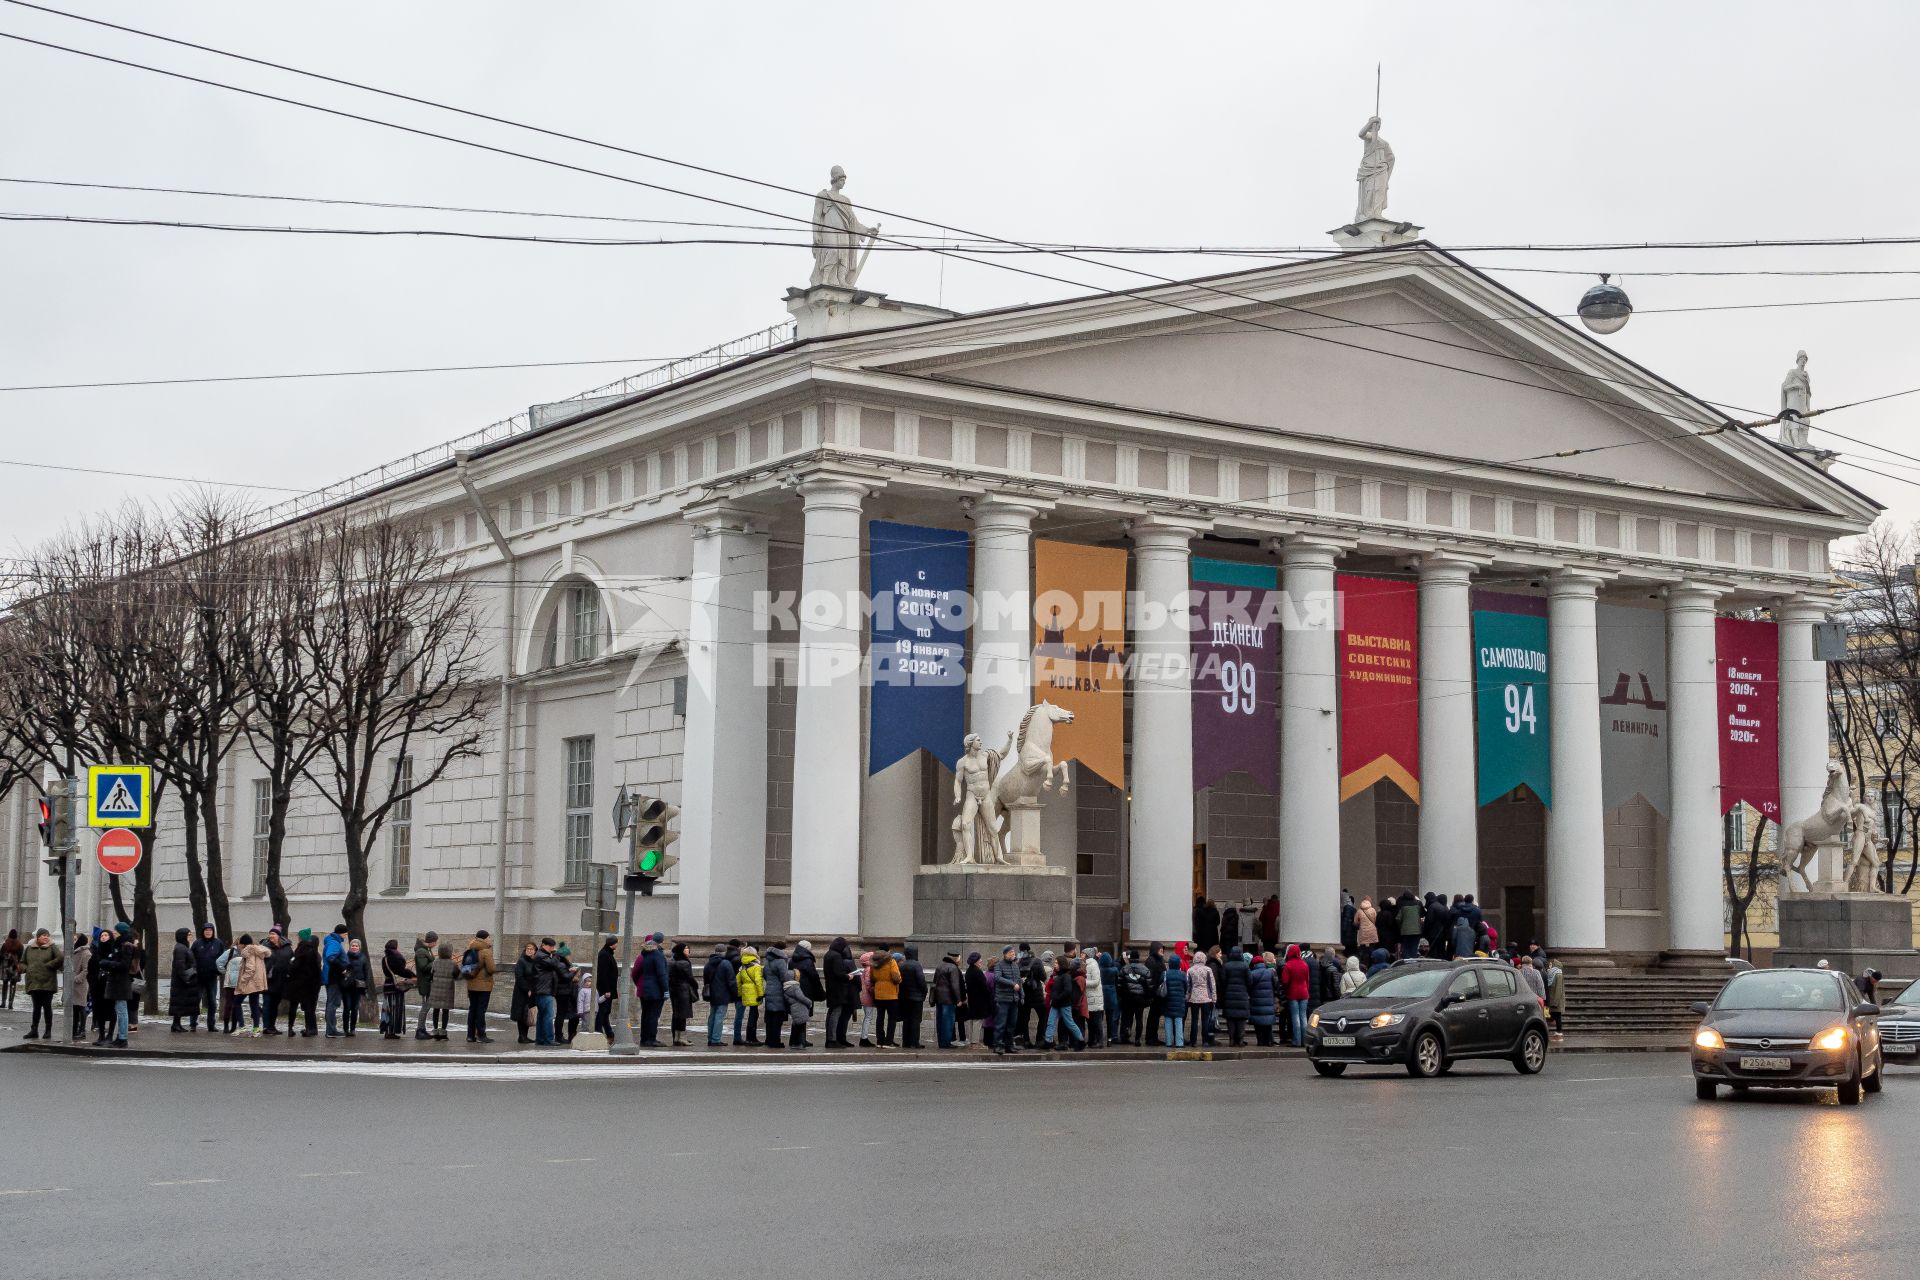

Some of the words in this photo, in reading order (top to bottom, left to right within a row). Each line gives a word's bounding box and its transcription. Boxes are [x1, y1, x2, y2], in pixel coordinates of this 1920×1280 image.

[895, 581, 910, 596] 18
[911, 587, 949, 600] НОЯБРЯ
[1211, 618, 1263, 649] ДЕЙНЕКА
[896, 639, 912, 654] 19
[912, 646, 950, 657] ЯНВАРЯ
[1348, 652, 1411, 669] СОВЕТСКИХ
[1480, 647, 1546, 673] САМОХВАЛОВ
[1050, 673, 1101, 692] МОСКВА
[1728, 666, 1737, 679] 18
[1736, 672, 1762, 681] НОЯБРЯ
[1221, 660, 1256, 715] 99
[1504, 684, 1537, 735] 94
[1612, 719, 1659, 738] ЛЕНИНГРАД
[1763, 802, 1778, 813] 12+
